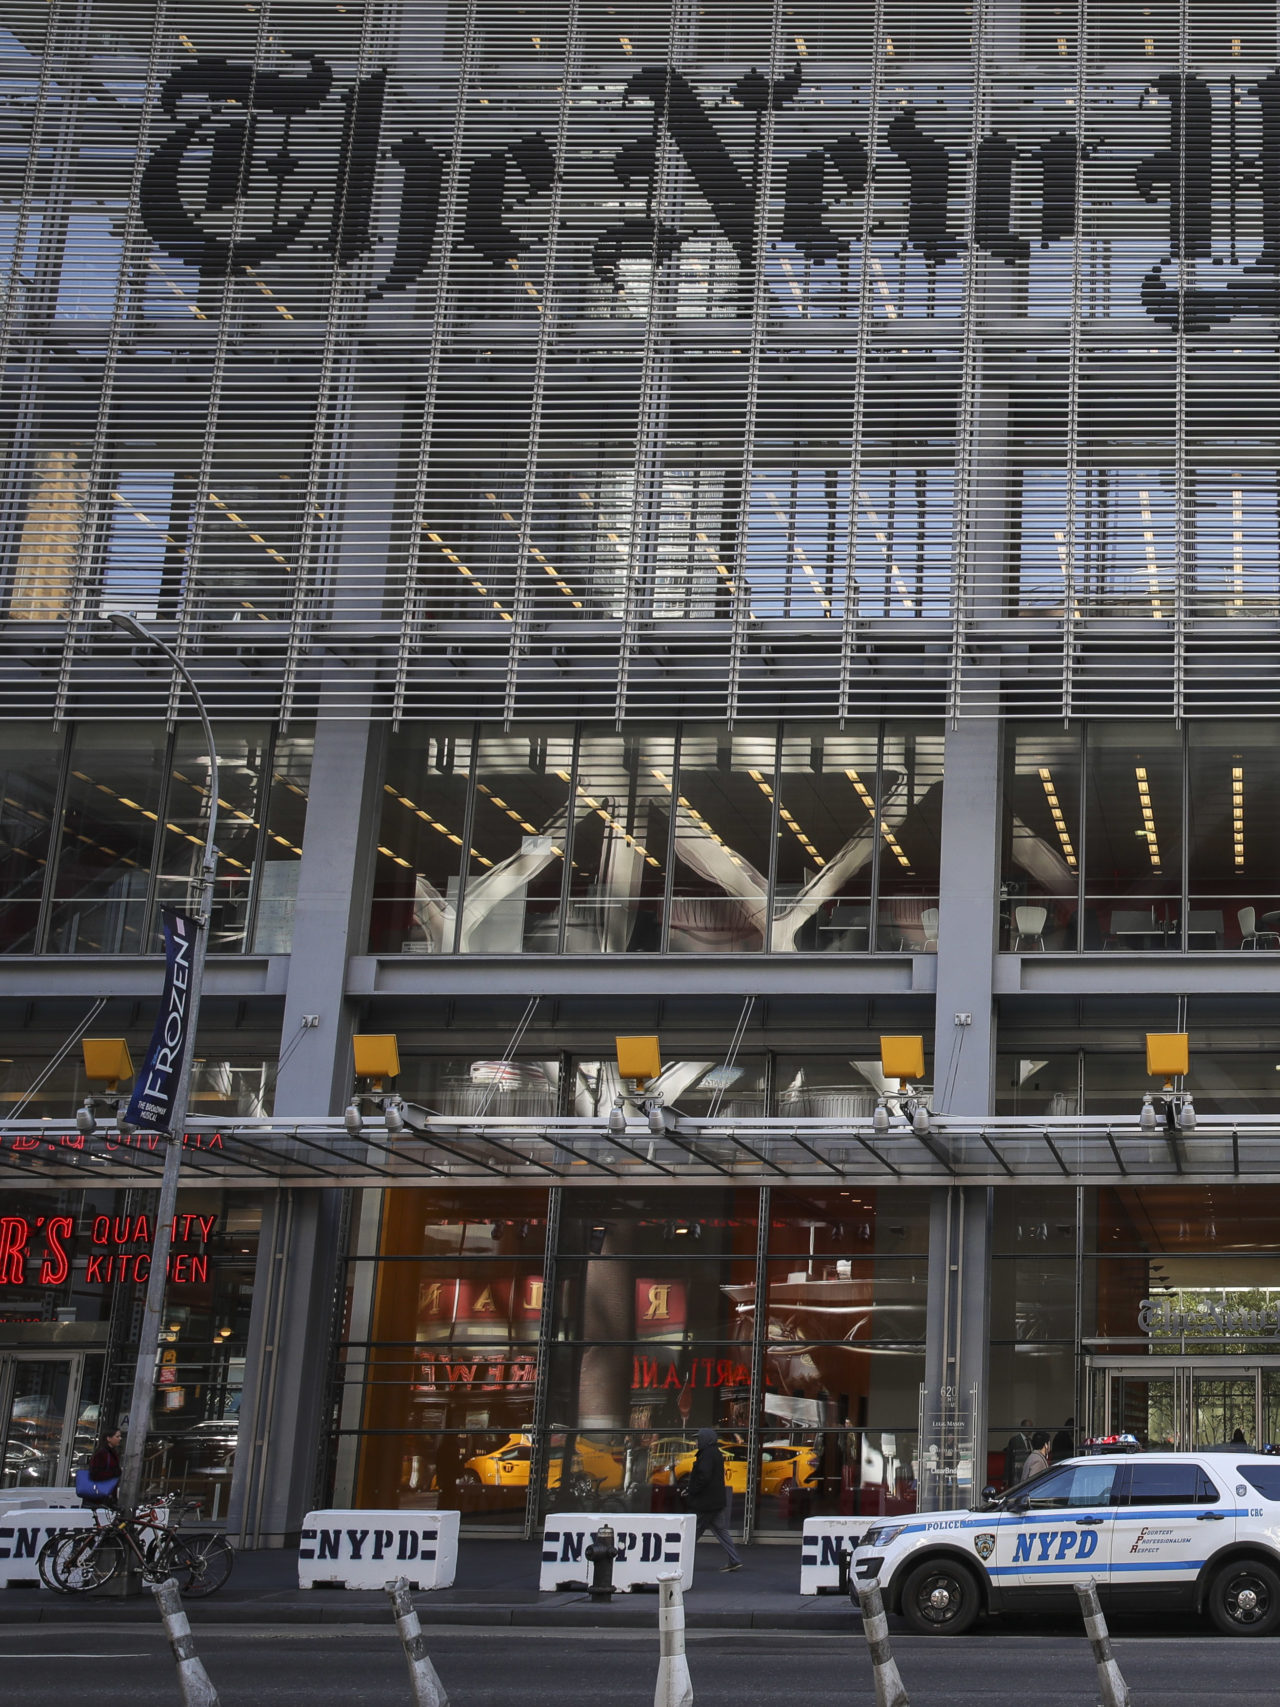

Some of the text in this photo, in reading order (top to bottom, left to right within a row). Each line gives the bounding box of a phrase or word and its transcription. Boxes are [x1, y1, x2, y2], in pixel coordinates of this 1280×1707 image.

[139, 55, 565, 299] The
[590, 62, 1110, 298] New
[143, 935, 190, 1101] FROZEN
[91, 1214, 217, 1245] QUAITY
[85, 1254, 209, 1283] KITCEN
[1137, 1299, 1198, 1333] The
[1197, 1299, 1268, 1334] New
[940, 1385, 957, 1397] 620
[926, 1519, 960, 1531] POLICE
[317, 1529, 420, 1560] NYPD
[561, 1531, 662, 1562] NPD
[1012, 1529, 1099, 1563] NYPD
